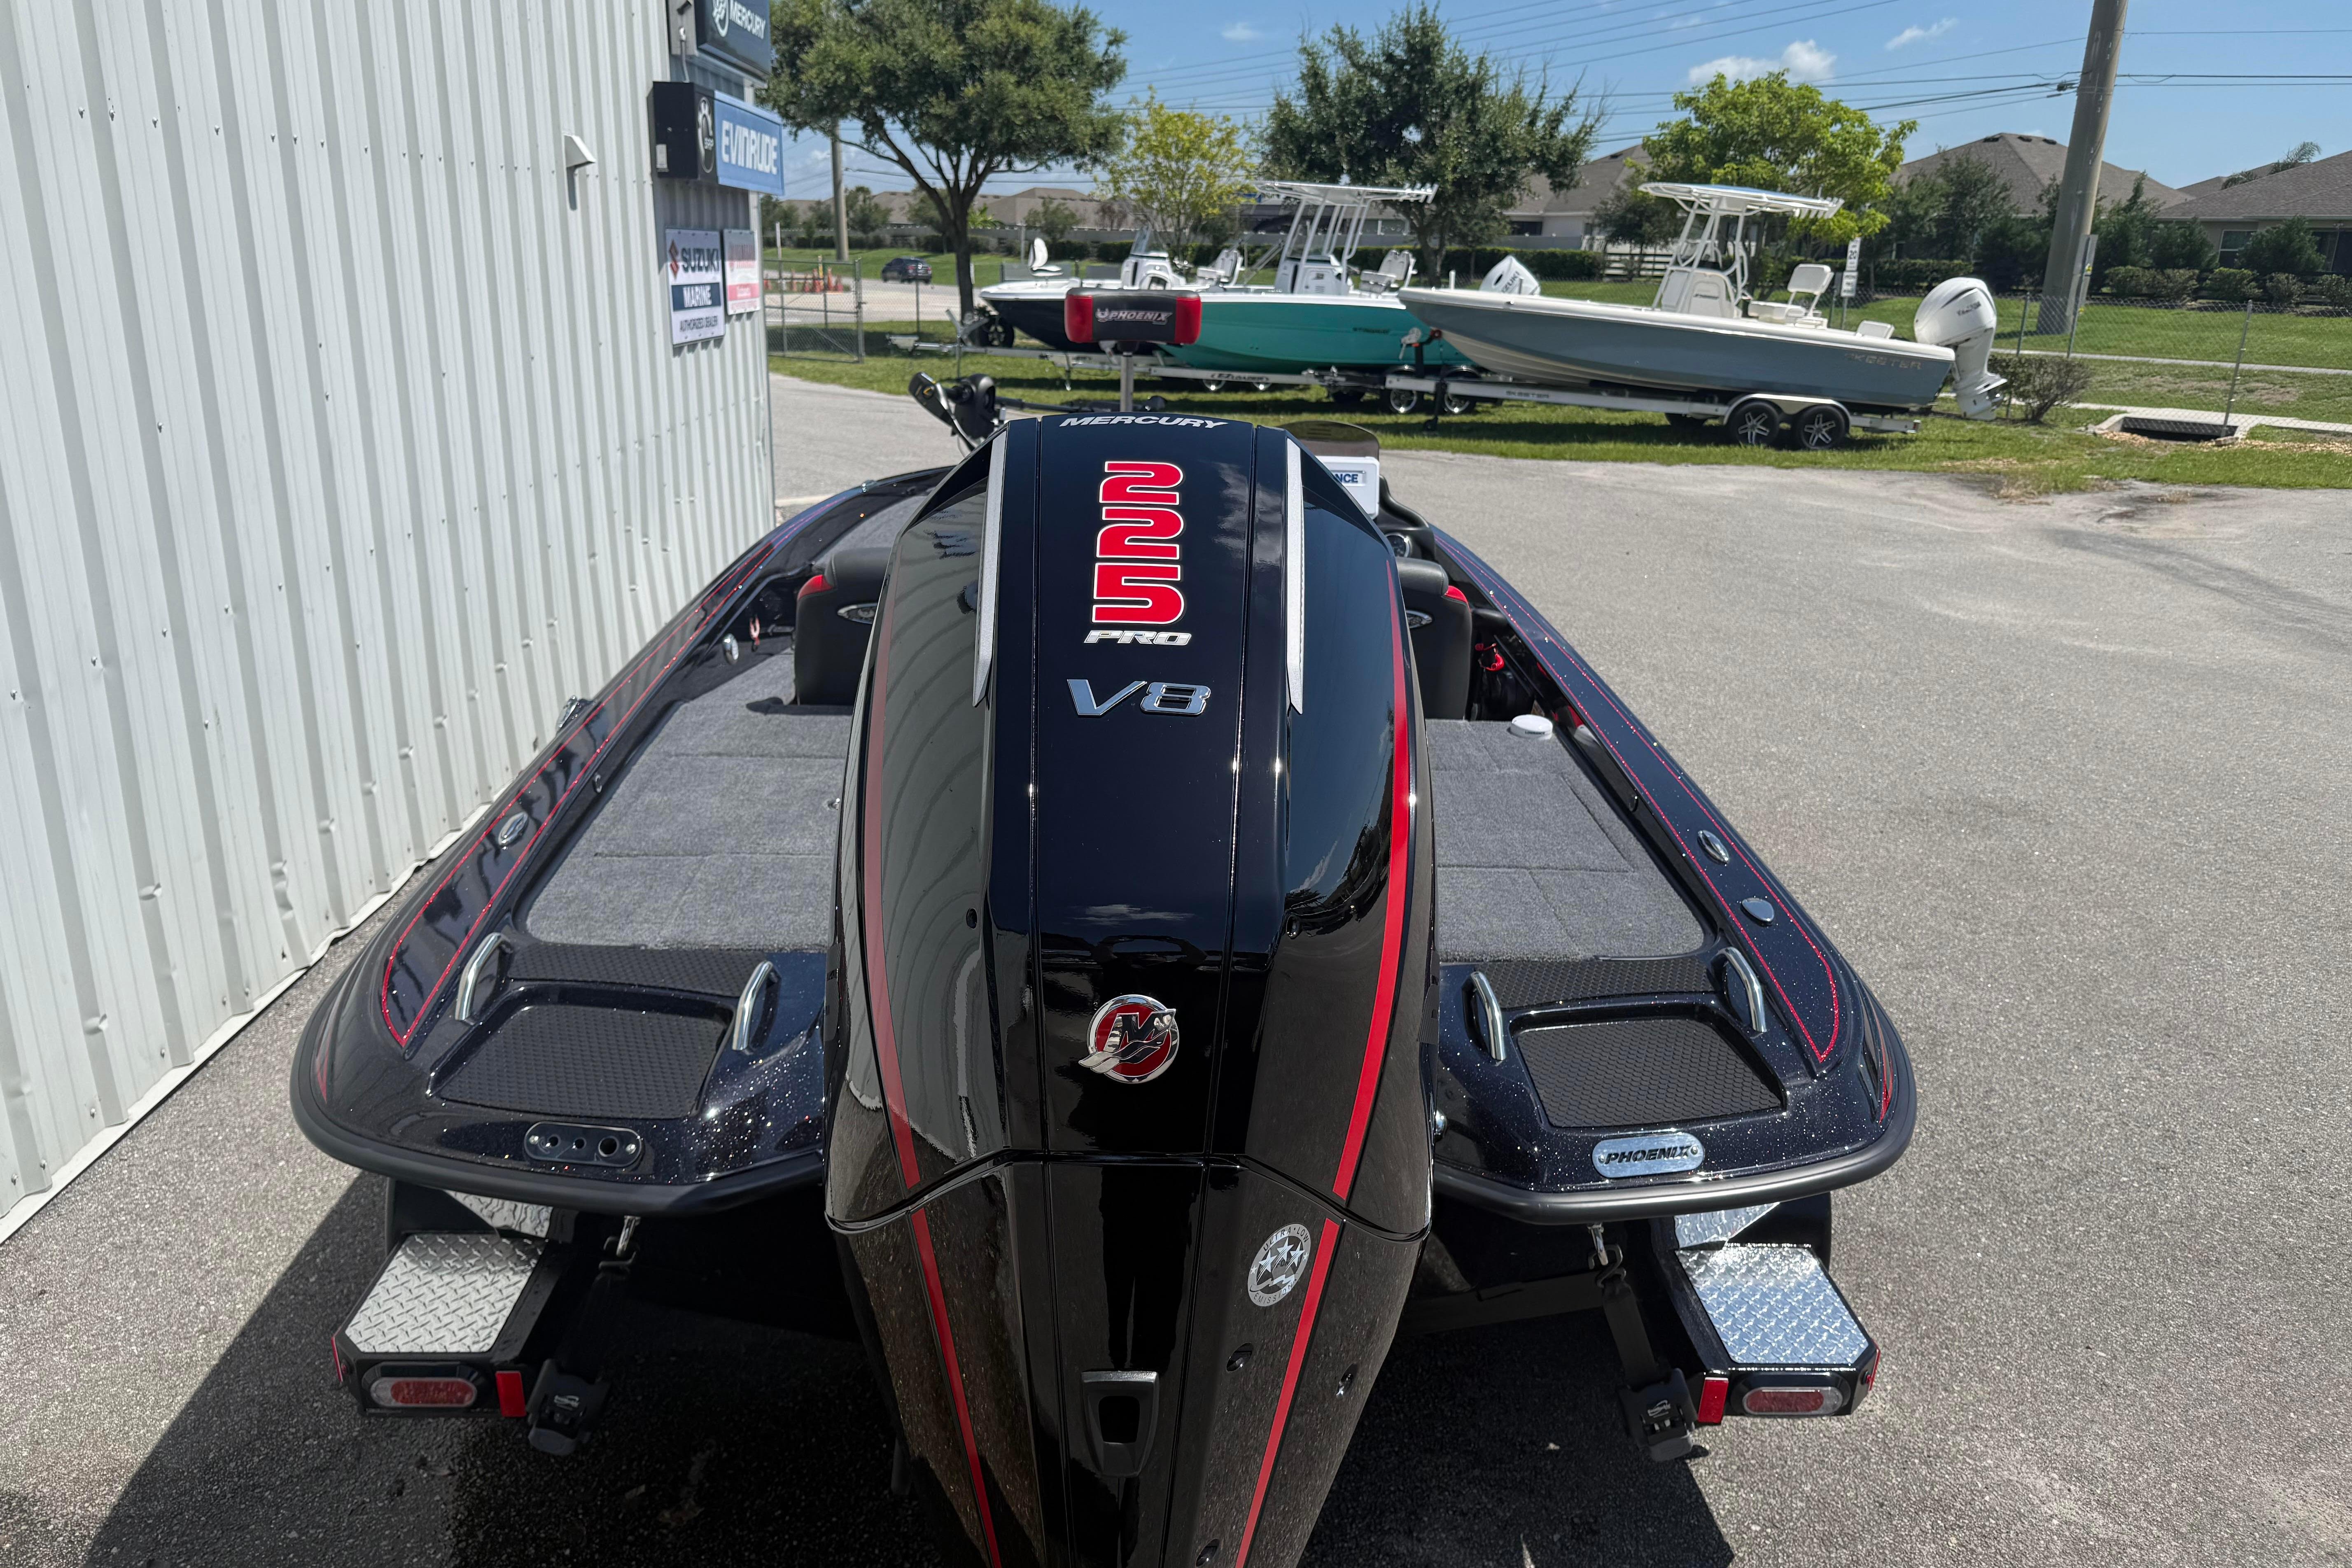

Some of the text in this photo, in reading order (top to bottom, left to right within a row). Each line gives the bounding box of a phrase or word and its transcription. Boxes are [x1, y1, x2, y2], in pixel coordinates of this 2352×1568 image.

[730, 0, 765, 39] MERCURY
[722, 120, 777, 175] EVINRUDE
[681, 247, 719, 273] SUZUKI
[1501, 270, 1520, 293] ZUKI
[684, 285, 712, 308] MARINE
[1109, 310, 1170, 322] PHOENIX
[1059, 416, 1228, 429] MERCURY
[1335, 474, 1358, 483] NCE
[1092, 461, 1184, 625] 225
[1084, 630, 1192, 646] PRO
[1066, 679, 1211, 717] V8
[1605, 1145, 1692, 1164] PHOENIX
[1263, 1226, 1309, 1251] ULTRA LOW
[1253, 1281, 1293, 1304] EMISSION
